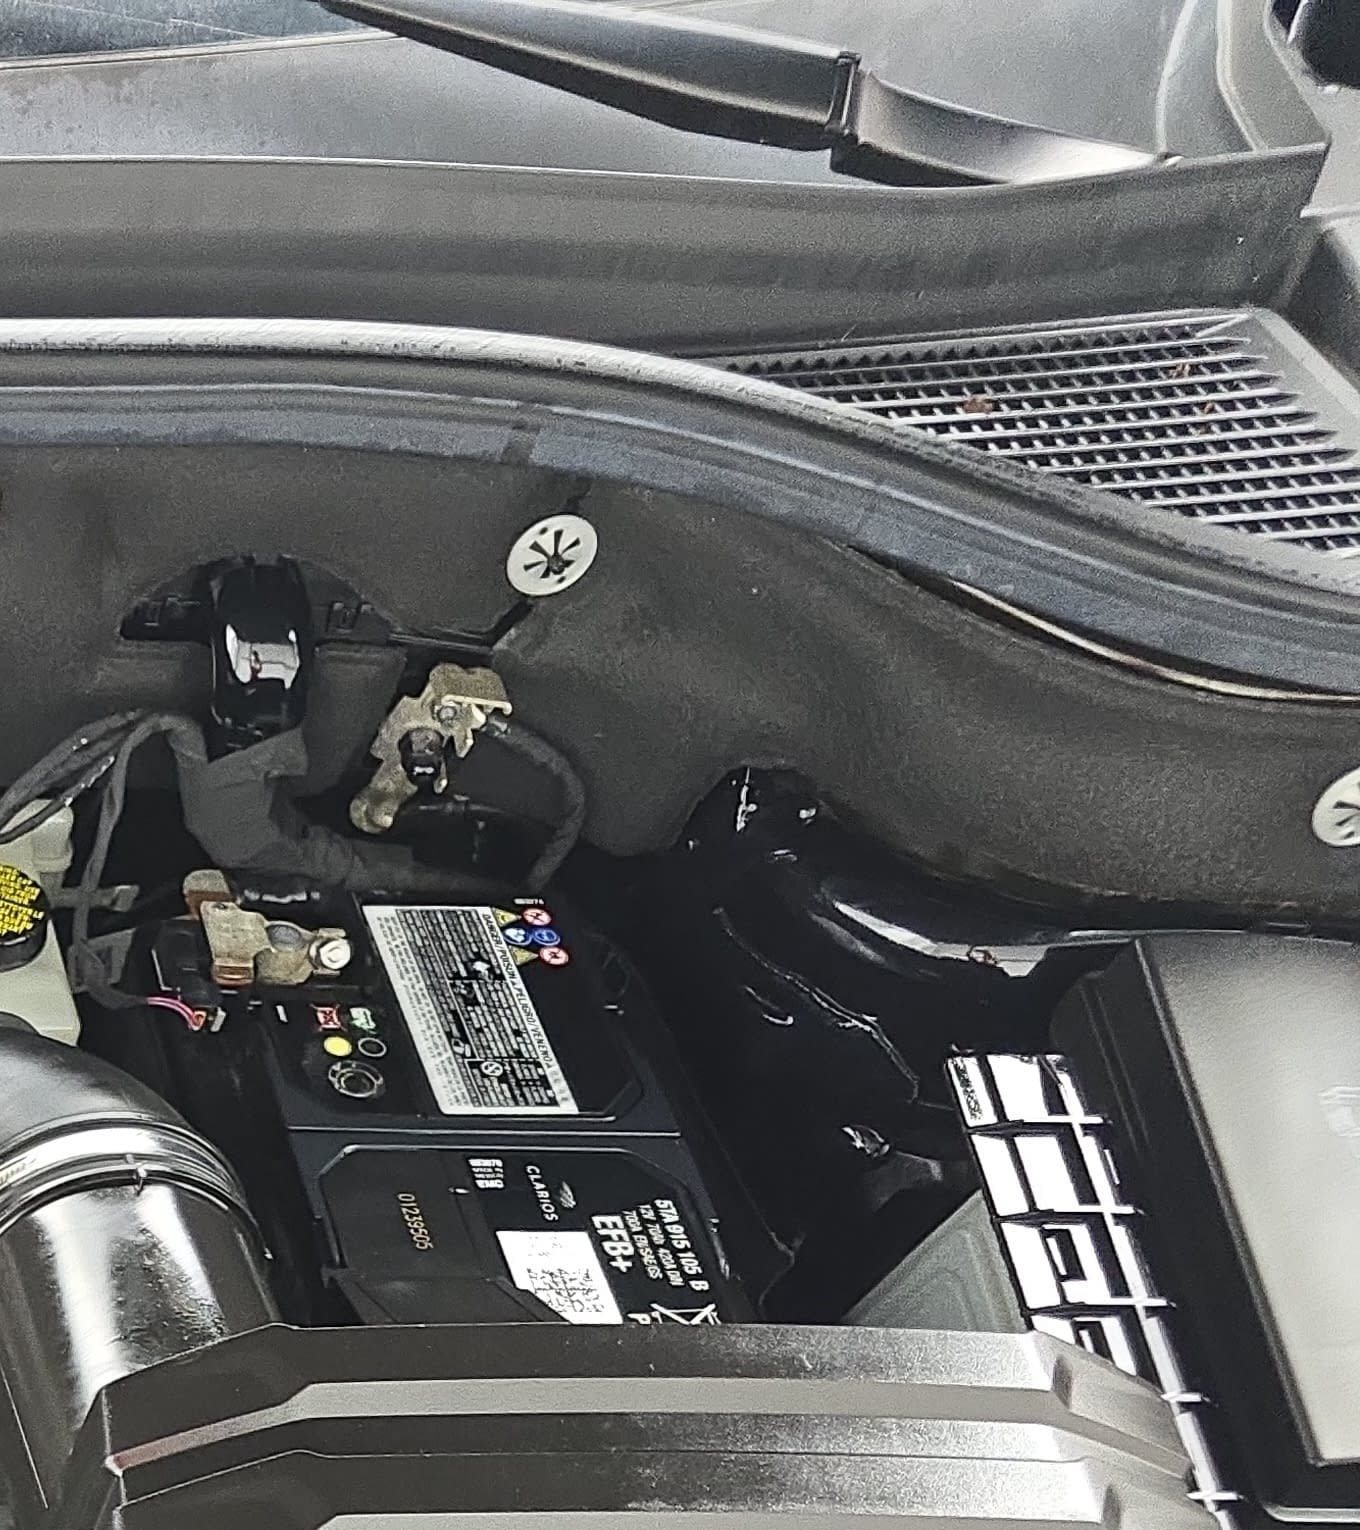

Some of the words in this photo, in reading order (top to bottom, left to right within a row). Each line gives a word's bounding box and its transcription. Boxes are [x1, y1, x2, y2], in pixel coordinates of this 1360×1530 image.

[525, 1164, 559, 1222] CLARIOS
[396, 1192, 434, 1250] 01239505
[654, 1198, 680, 1224] 5TA
[591, 1214, 635, 1273] EFB+
[664, 1224, 692, 1250] 915
[676, 1251, 703, 1276] 105
[688, 1279, 710, 1292] B
